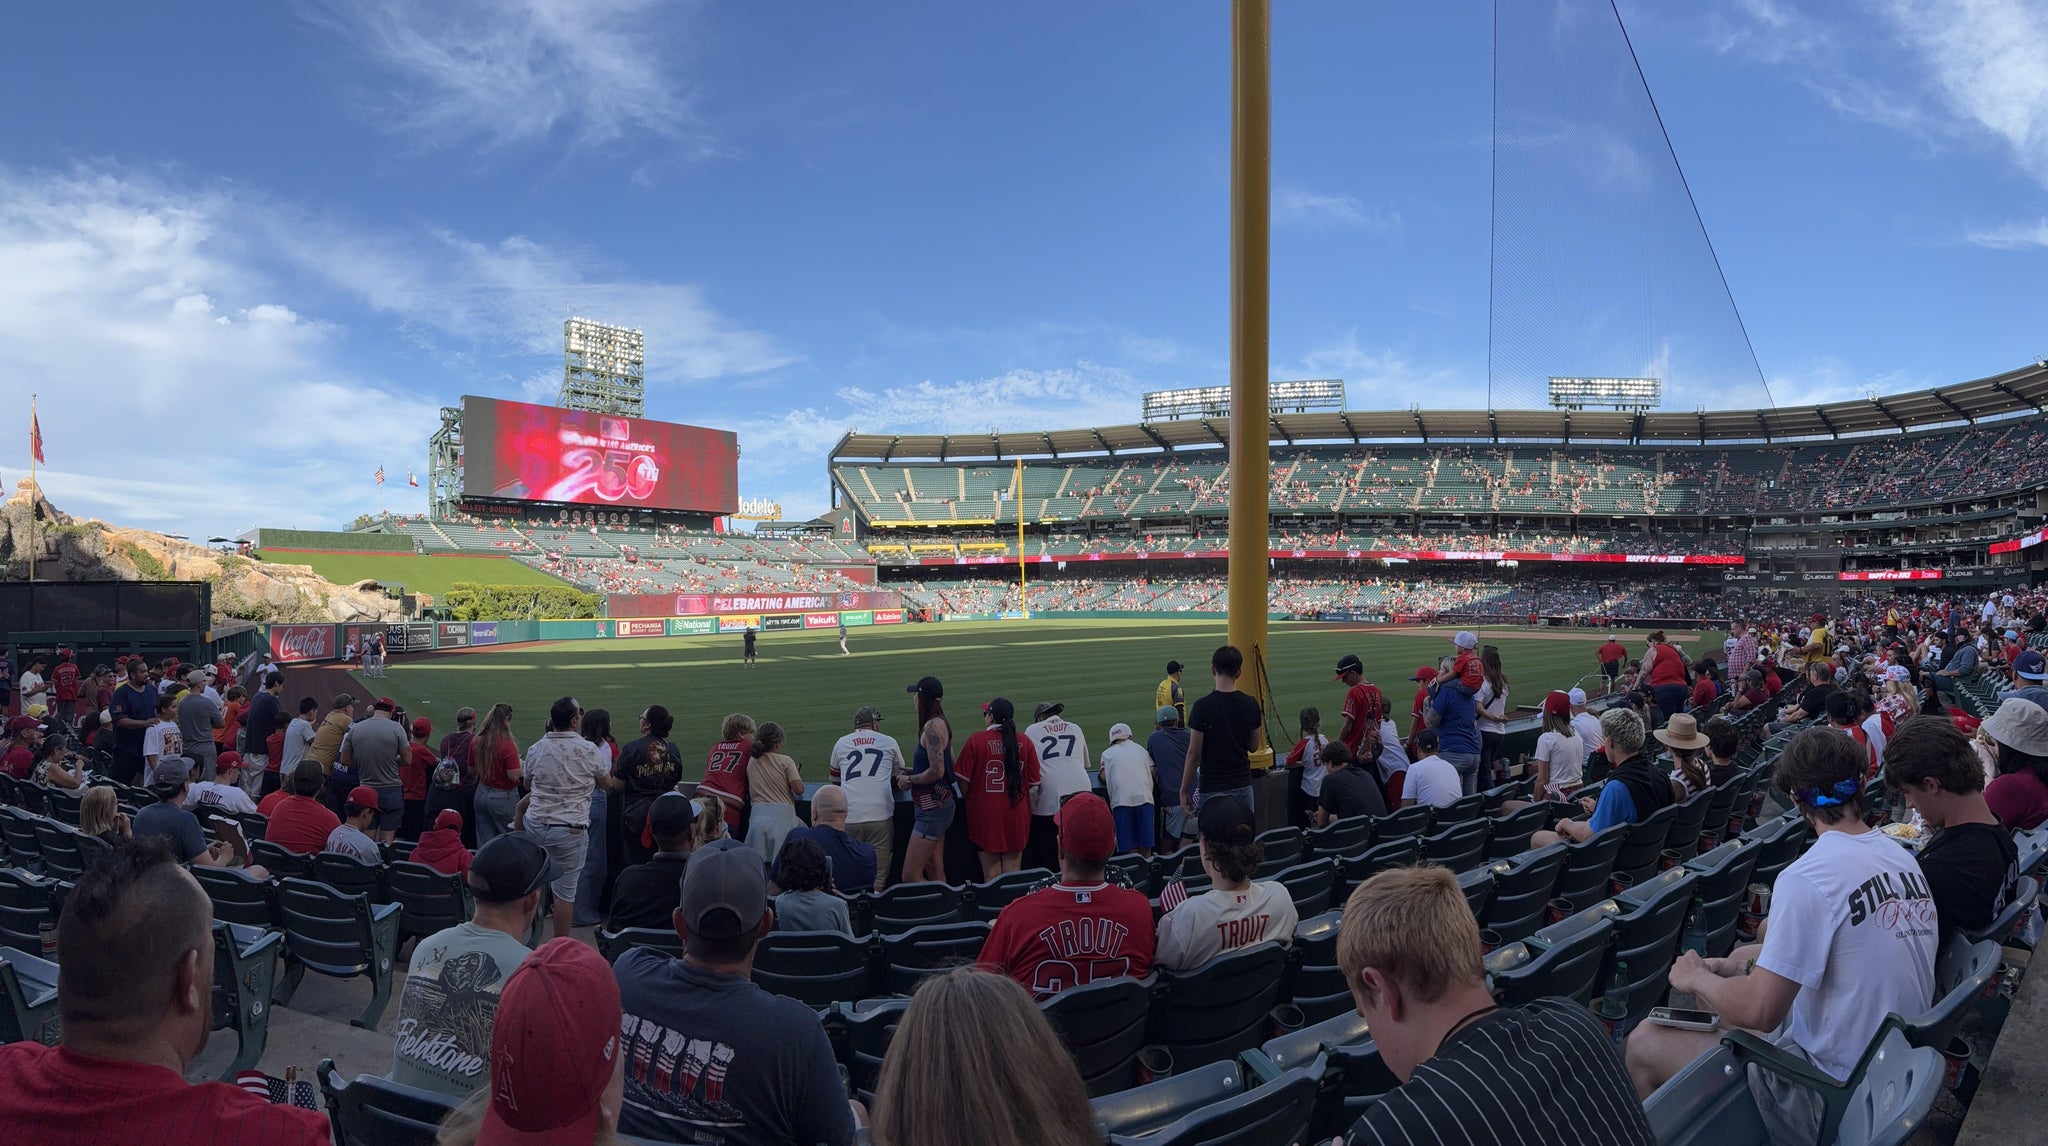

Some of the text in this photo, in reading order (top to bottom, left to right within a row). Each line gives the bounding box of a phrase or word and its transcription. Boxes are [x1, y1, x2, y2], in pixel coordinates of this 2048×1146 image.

[558, 448, 657, 502] 250
[488, 505, 522, 514] BOURBON
[738, 496, 774, 516] odelo
[1666, 555, 1685, 563] JULY
[714, 596, 783, 611] CELEBRATING
[785, 595, 832, 609] AMERICA'S
[683, 619, 712, 630] National
[807, 615, 837, 625] Yakult
[280, 628, 327, 658] Coca-Cola
[1043, 723, 1069, 733] TROUT
[852, 737, 876, 747] TROUT
[1040, 735, 1076, 761] 27
[709, 751, 743, 773] 27
[846, 748, 884, 782] 27
[1848, 872, 1901, 927] STILL
[1039, 917, 1129, 960] TROUT
[1217, 914, 1270, 950] TROUT
[394, 1018, 484, 1078] Fieldstone
